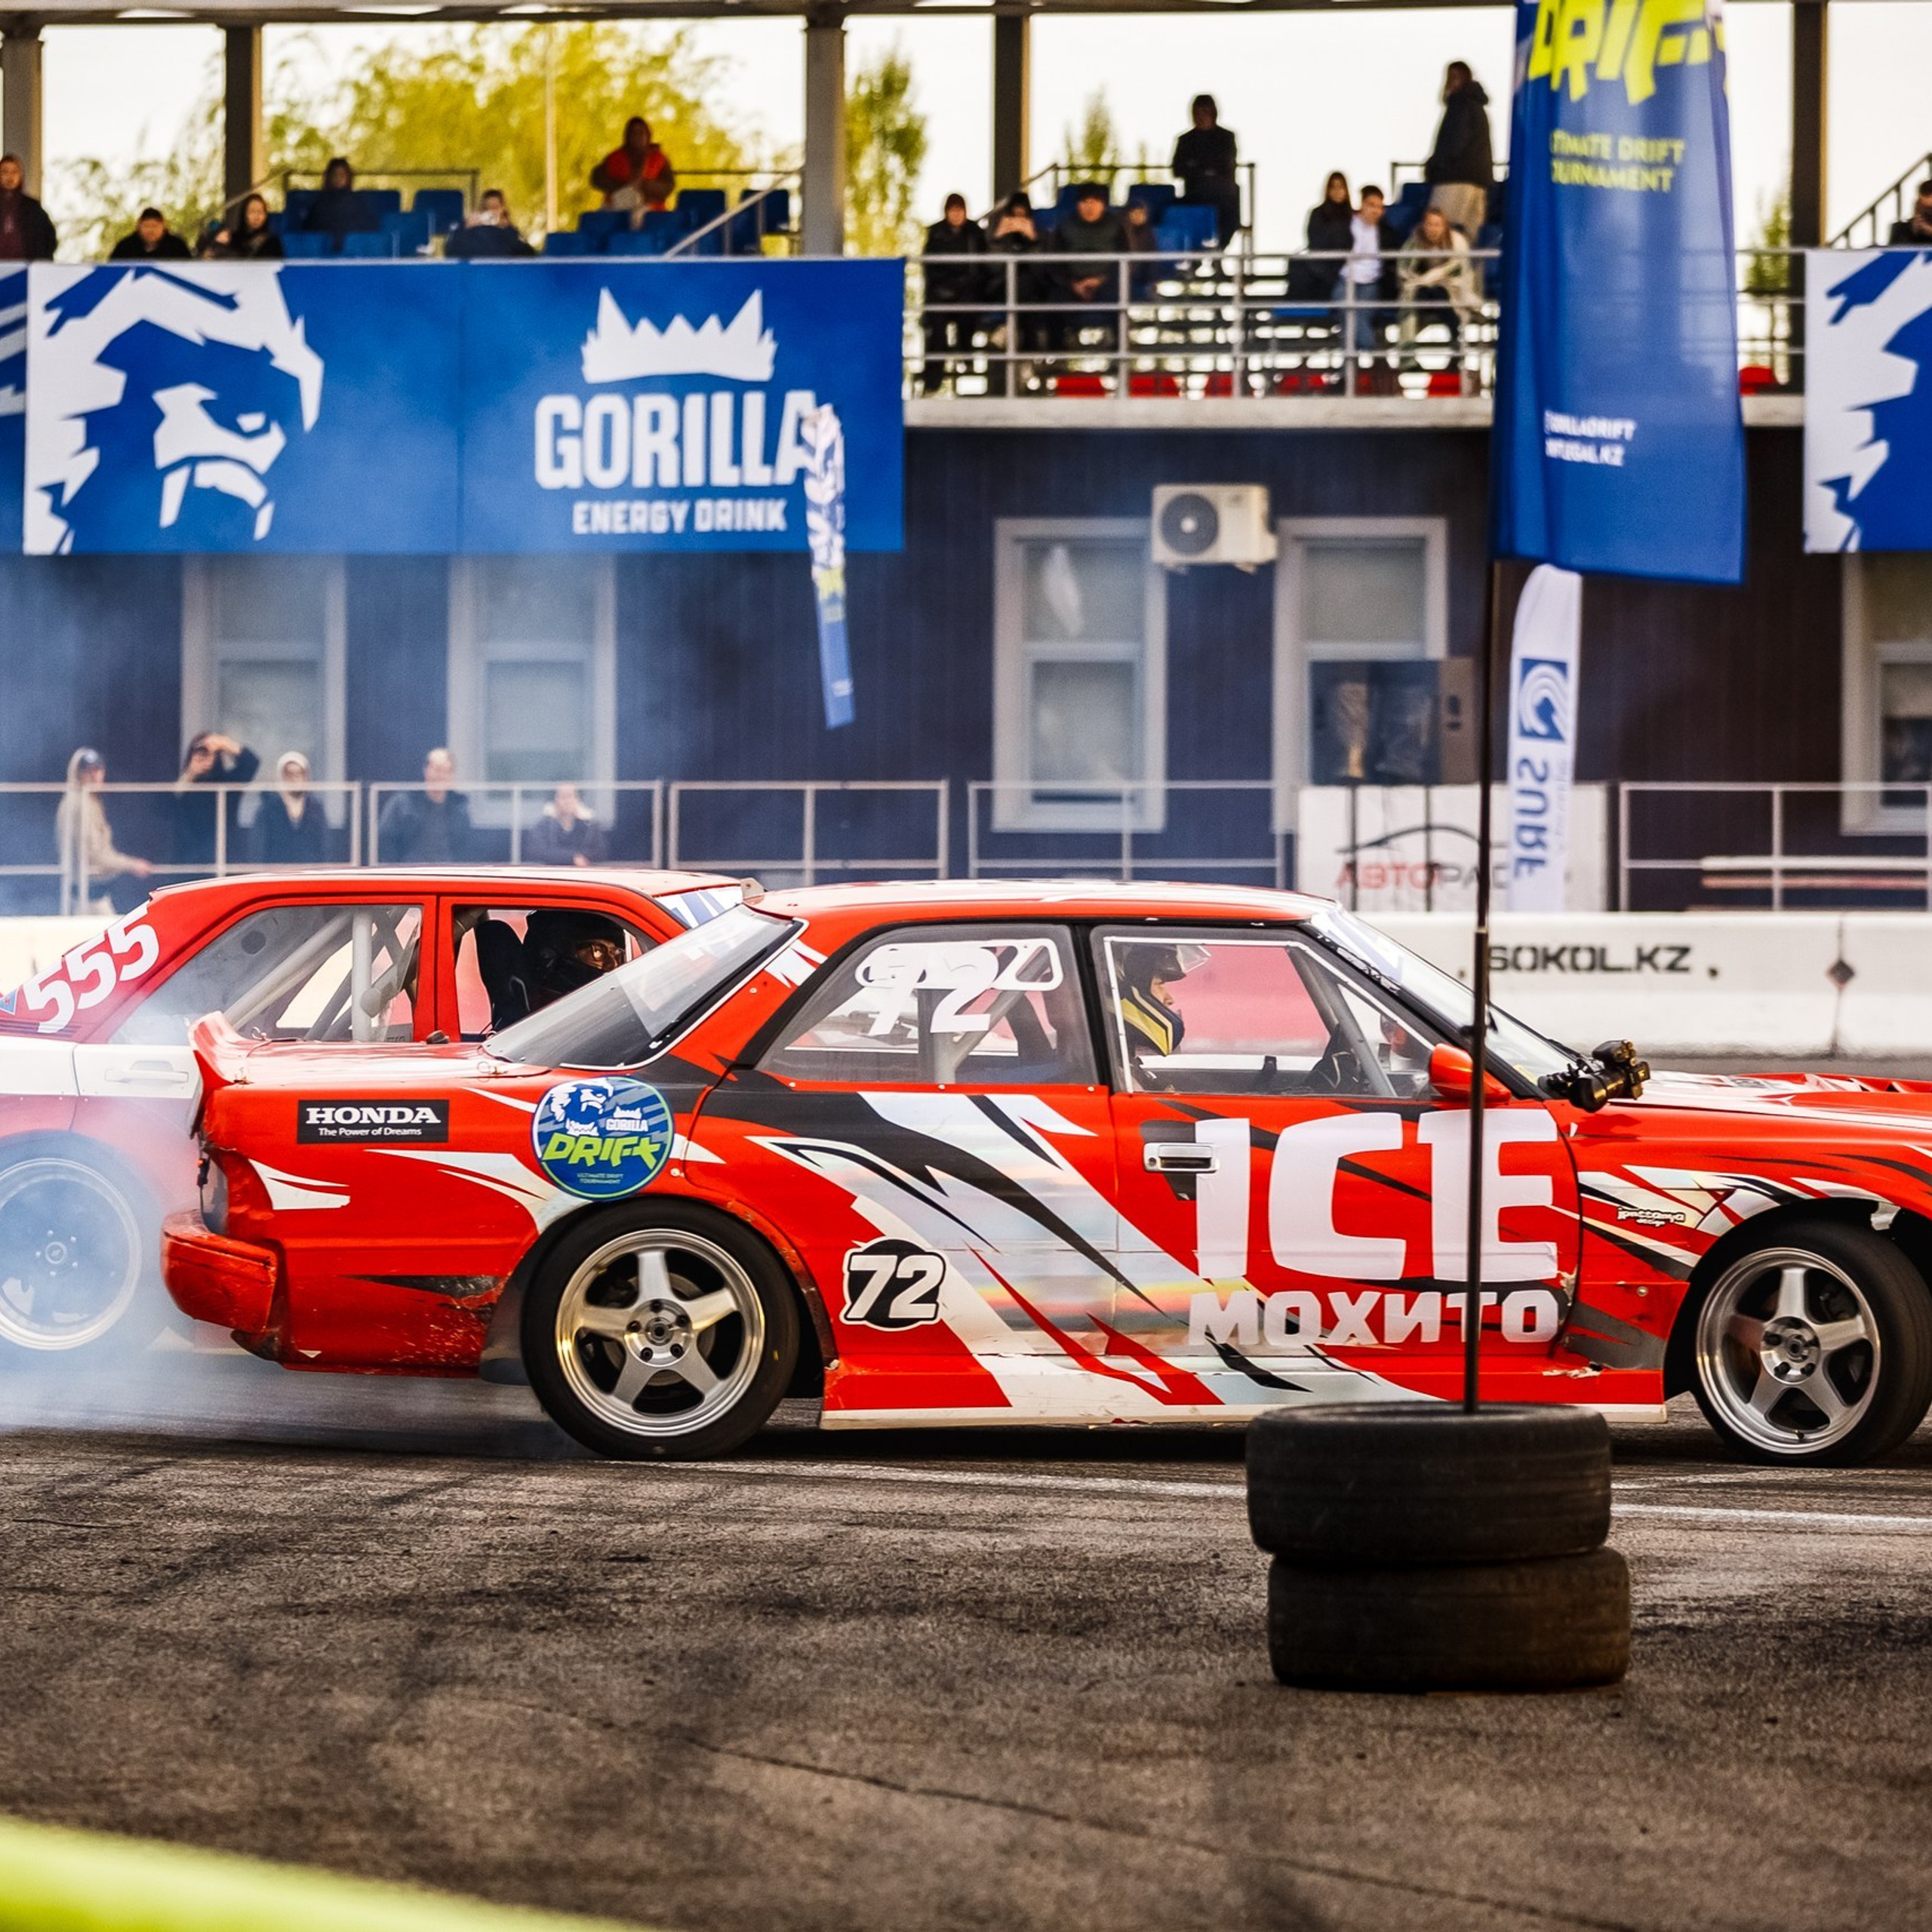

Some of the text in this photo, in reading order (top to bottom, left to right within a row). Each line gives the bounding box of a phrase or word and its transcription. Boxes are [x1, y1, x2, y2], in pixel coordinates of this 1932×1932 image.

[1618, 137, 1685, 164] DRIFT
[534, 390, 818, 489] GORILLA
[573, 498, 787, 534] ENERGY DRINK
[23, 900, 159, 1033] 555
[306, 1107, 441, 1124] HONDA
[318, 1128, 422, 1137] The Power of Dreams
[606, 1119, 648, 1132] GORILLA
[1195, 1109, 1558, 1281] ICE
[846, 1254, 944, 1318] 72
